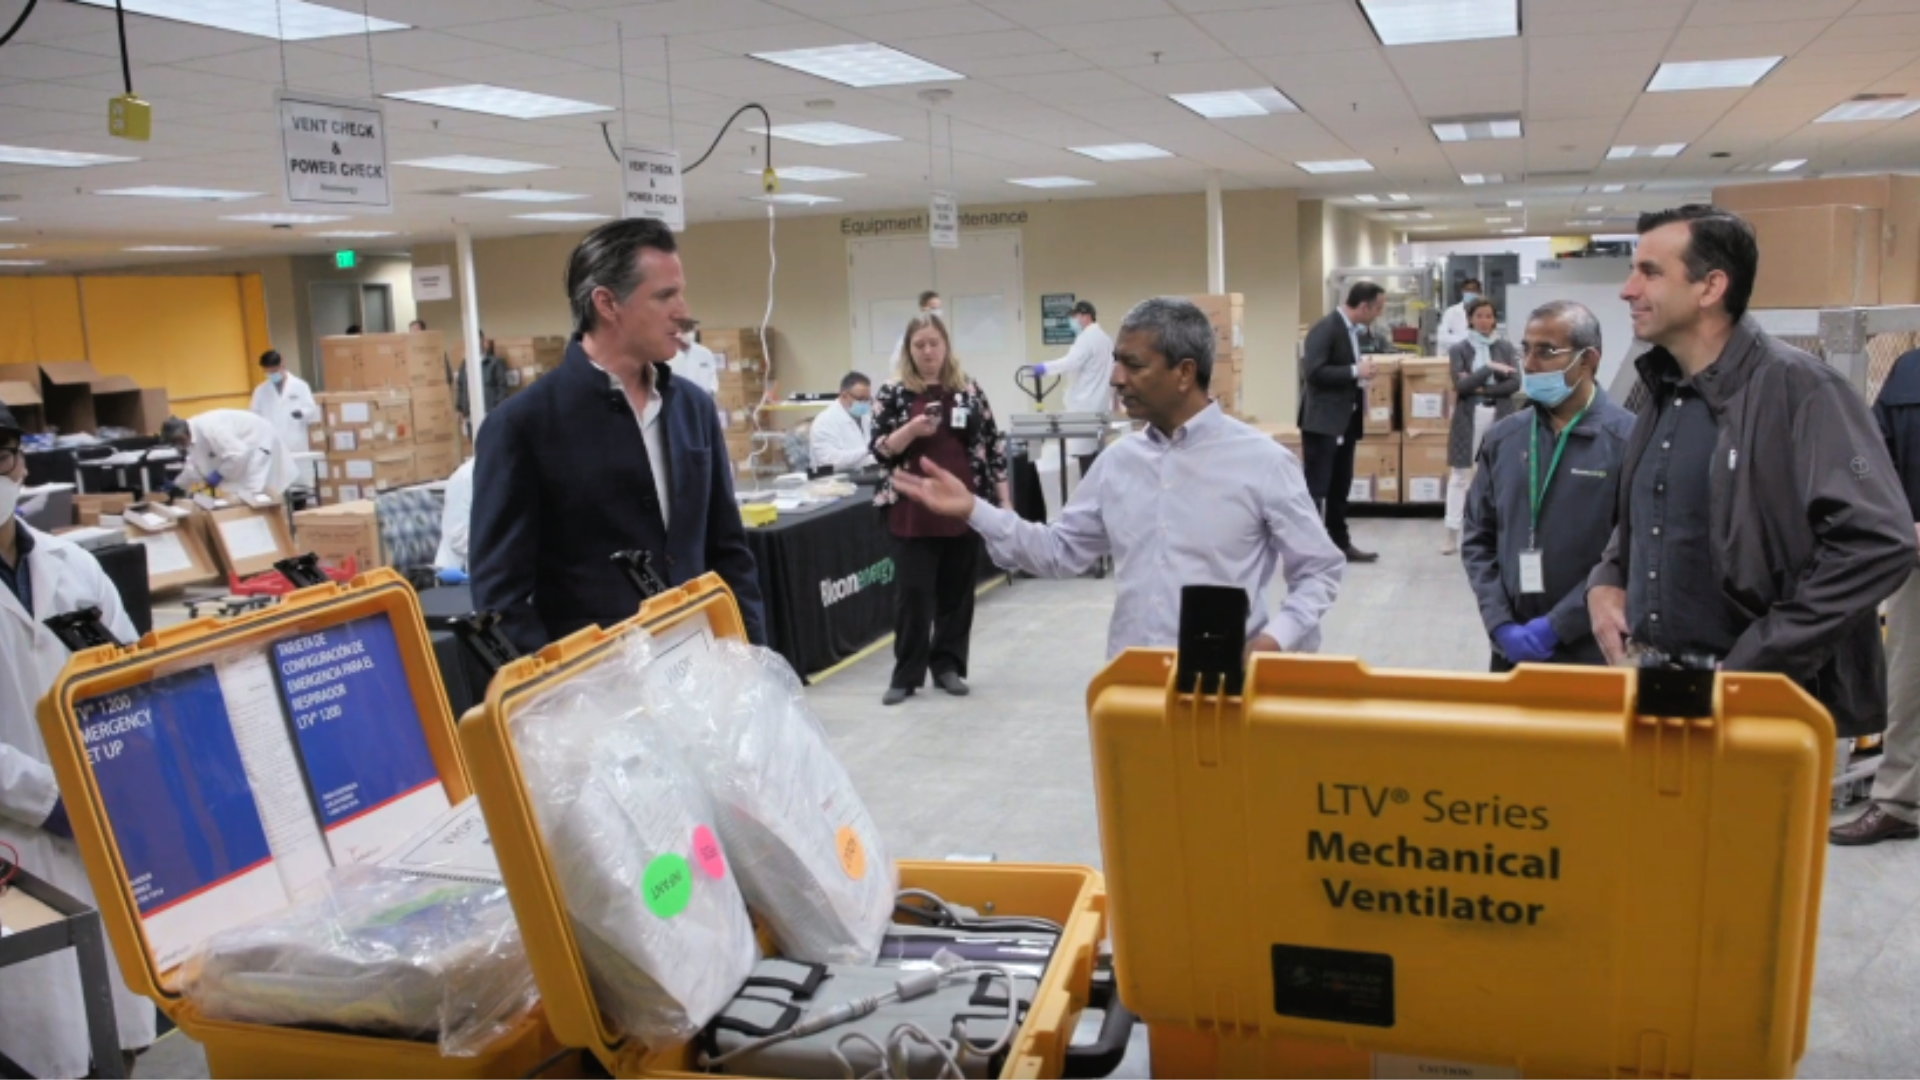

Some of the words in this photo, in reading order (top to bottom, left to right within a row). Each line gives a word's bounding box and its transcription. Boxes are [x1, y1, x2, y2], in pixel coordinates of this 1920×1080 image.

[292, 116, 327, 134] VENT
[331, 120, 375, 139] CHECK
[331, 140, 342, 155] &
[290, 158, 337, 176] POWER
[340, 162, 383, 179] CHECK
[650, 163, 674, 176] CHECK
[840, 216, 923, 235] Equipment
[312, 632, 327, 648] DE
[287, 664, 342, 694] EMERGENCIA
[98, 693, 132, 715] 1200
[291, 683, 347, 712] RESPIRADOR
[83, 706, 153, 744] MERGENCY
[101, 739, 125, 760] UP
[1421, 788, 1550, 832] Series
[1306, 829, 1561, 882] Mechanical
[1320, 877, 1545, 928] Ventilator
